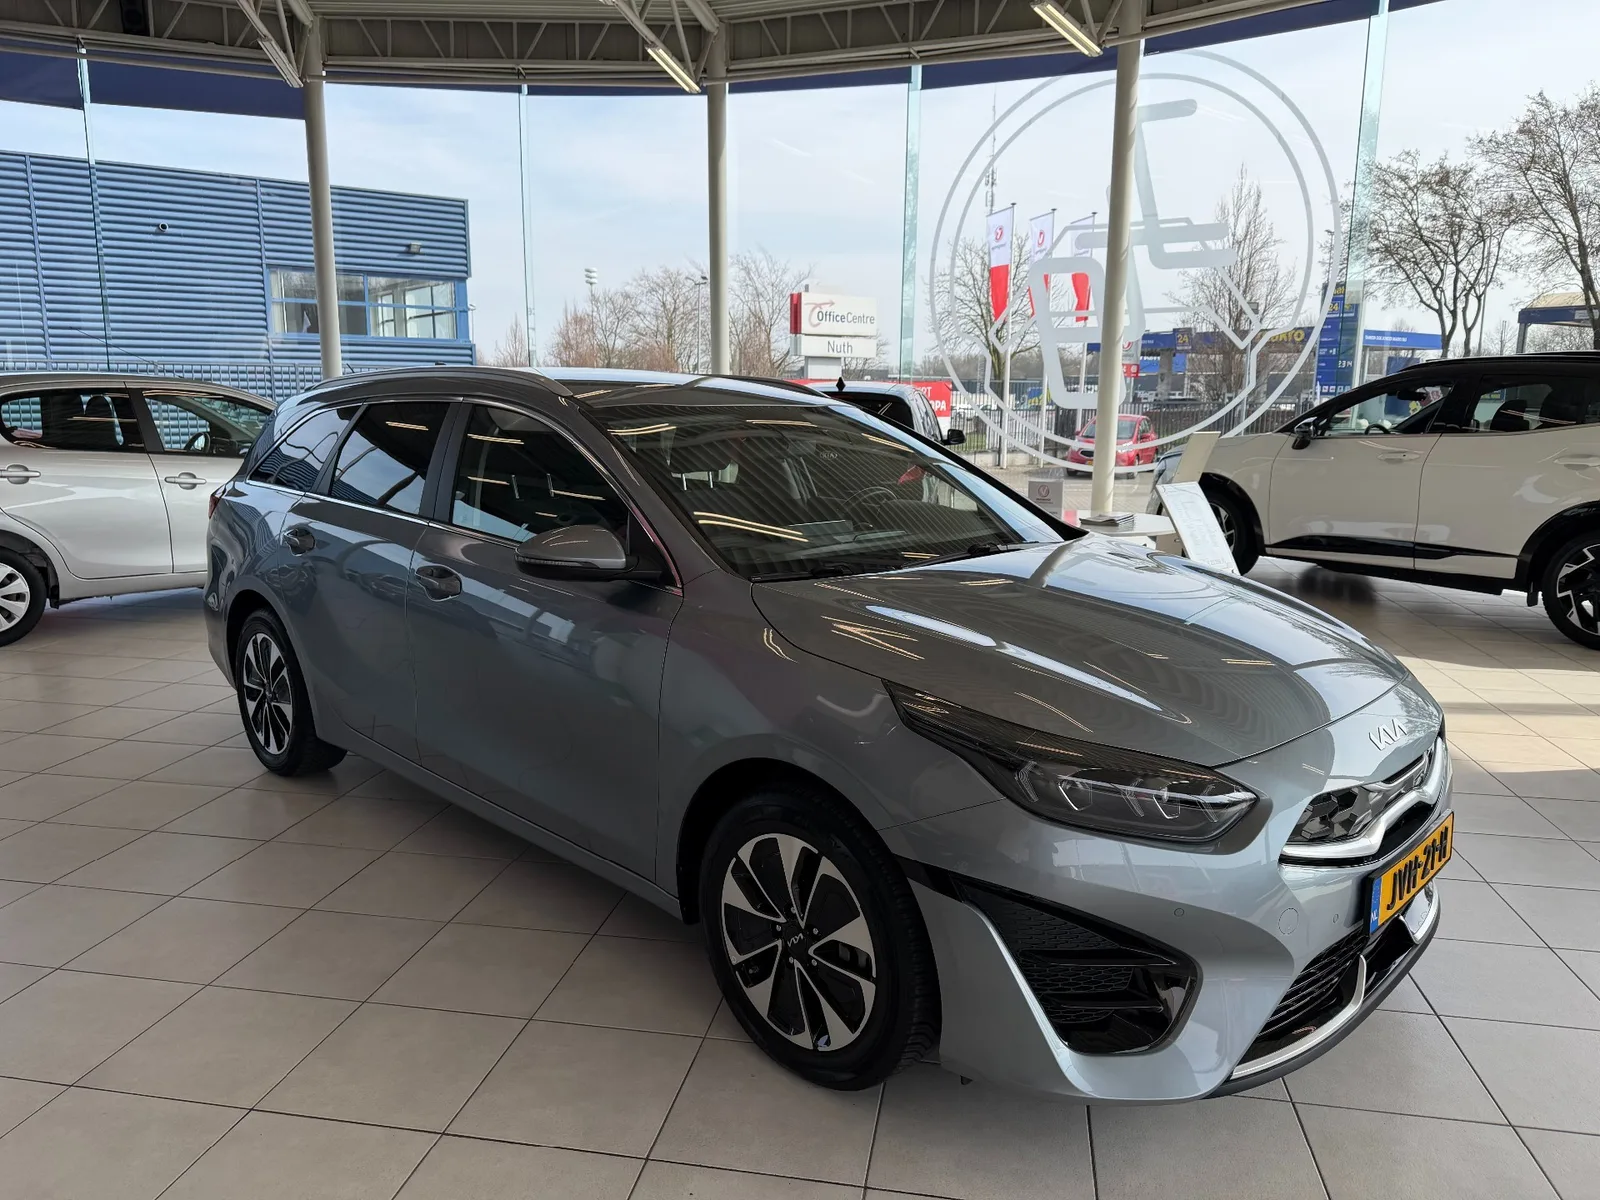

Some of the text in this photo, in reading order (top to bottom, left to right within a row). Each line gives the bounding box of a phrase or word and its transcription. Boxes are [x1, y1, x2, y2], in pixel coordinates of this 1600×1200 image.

[817, 311, 875, 325] OfficeCentre
[1177, 334, 1189, 344] 24
[827, 340, 853, 355] Nuth
[1368, 718, 1407, 751] KIA
[1386, 826, 1448, 911] JVH-21-H
[1370, 908, 1378, 924] NL
